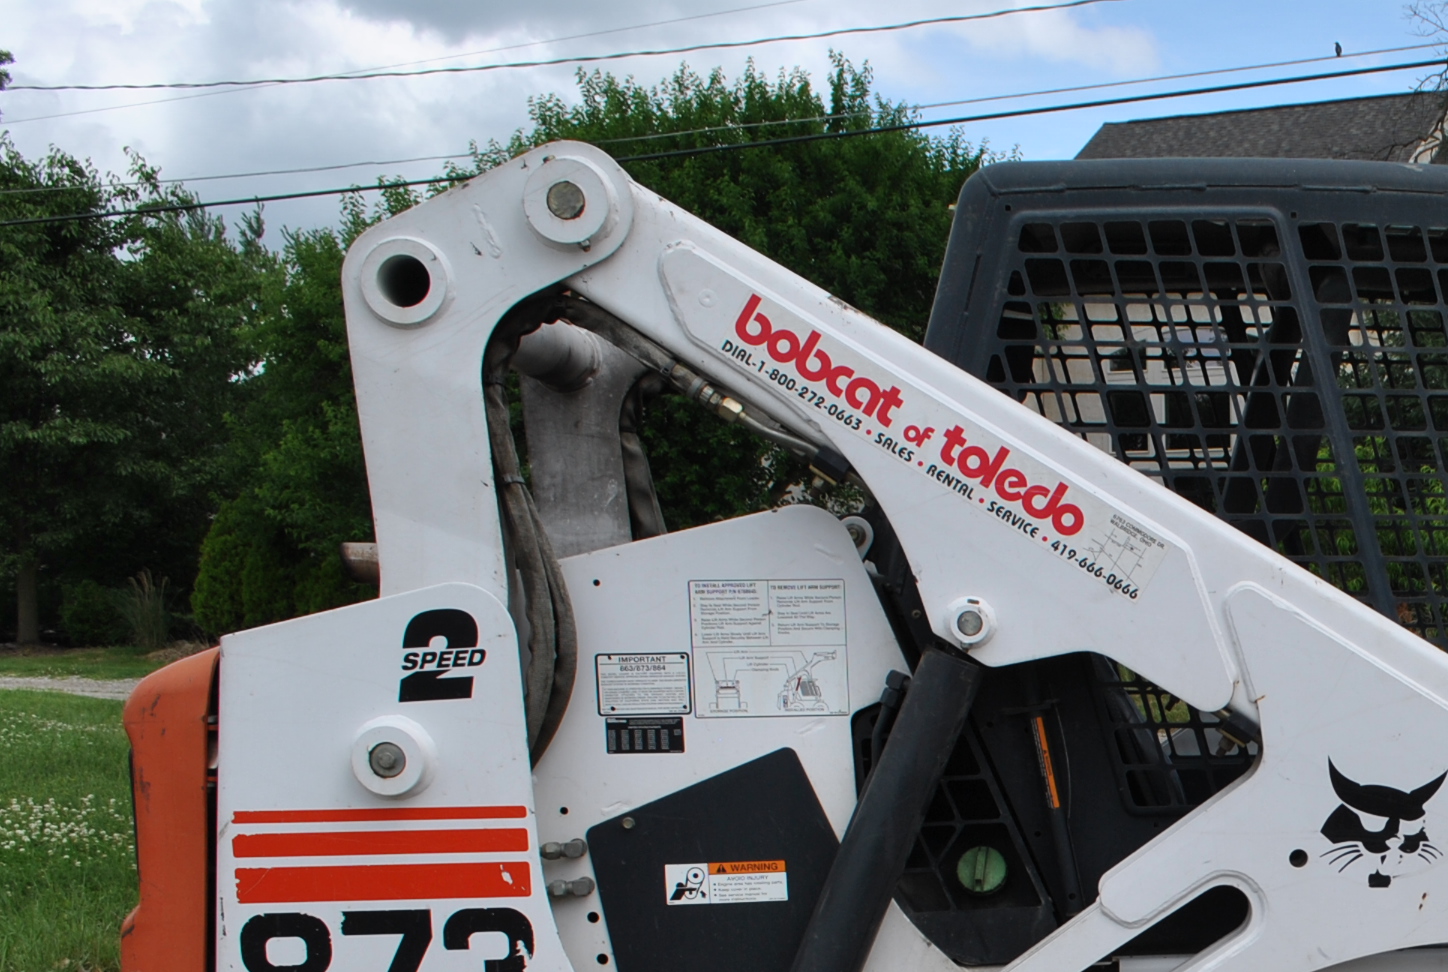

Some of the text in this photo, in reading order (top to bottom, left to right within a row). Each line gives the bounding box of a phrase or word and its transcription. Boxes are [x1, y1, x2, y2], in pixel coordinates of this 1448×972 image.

[735, 293, 1085, 537] bobcat of toledo
[721, 338, 1140, 600] DIAL-1-800-272-0663 SALES RENTAL SERVICE 419-666-0666
[398, 608, 479, 703] 2
[401, 648, 487, 671] SPEED
[618, 655, 667, 663] IMPORTANT
[730, 862, 779, 873] WARNING
